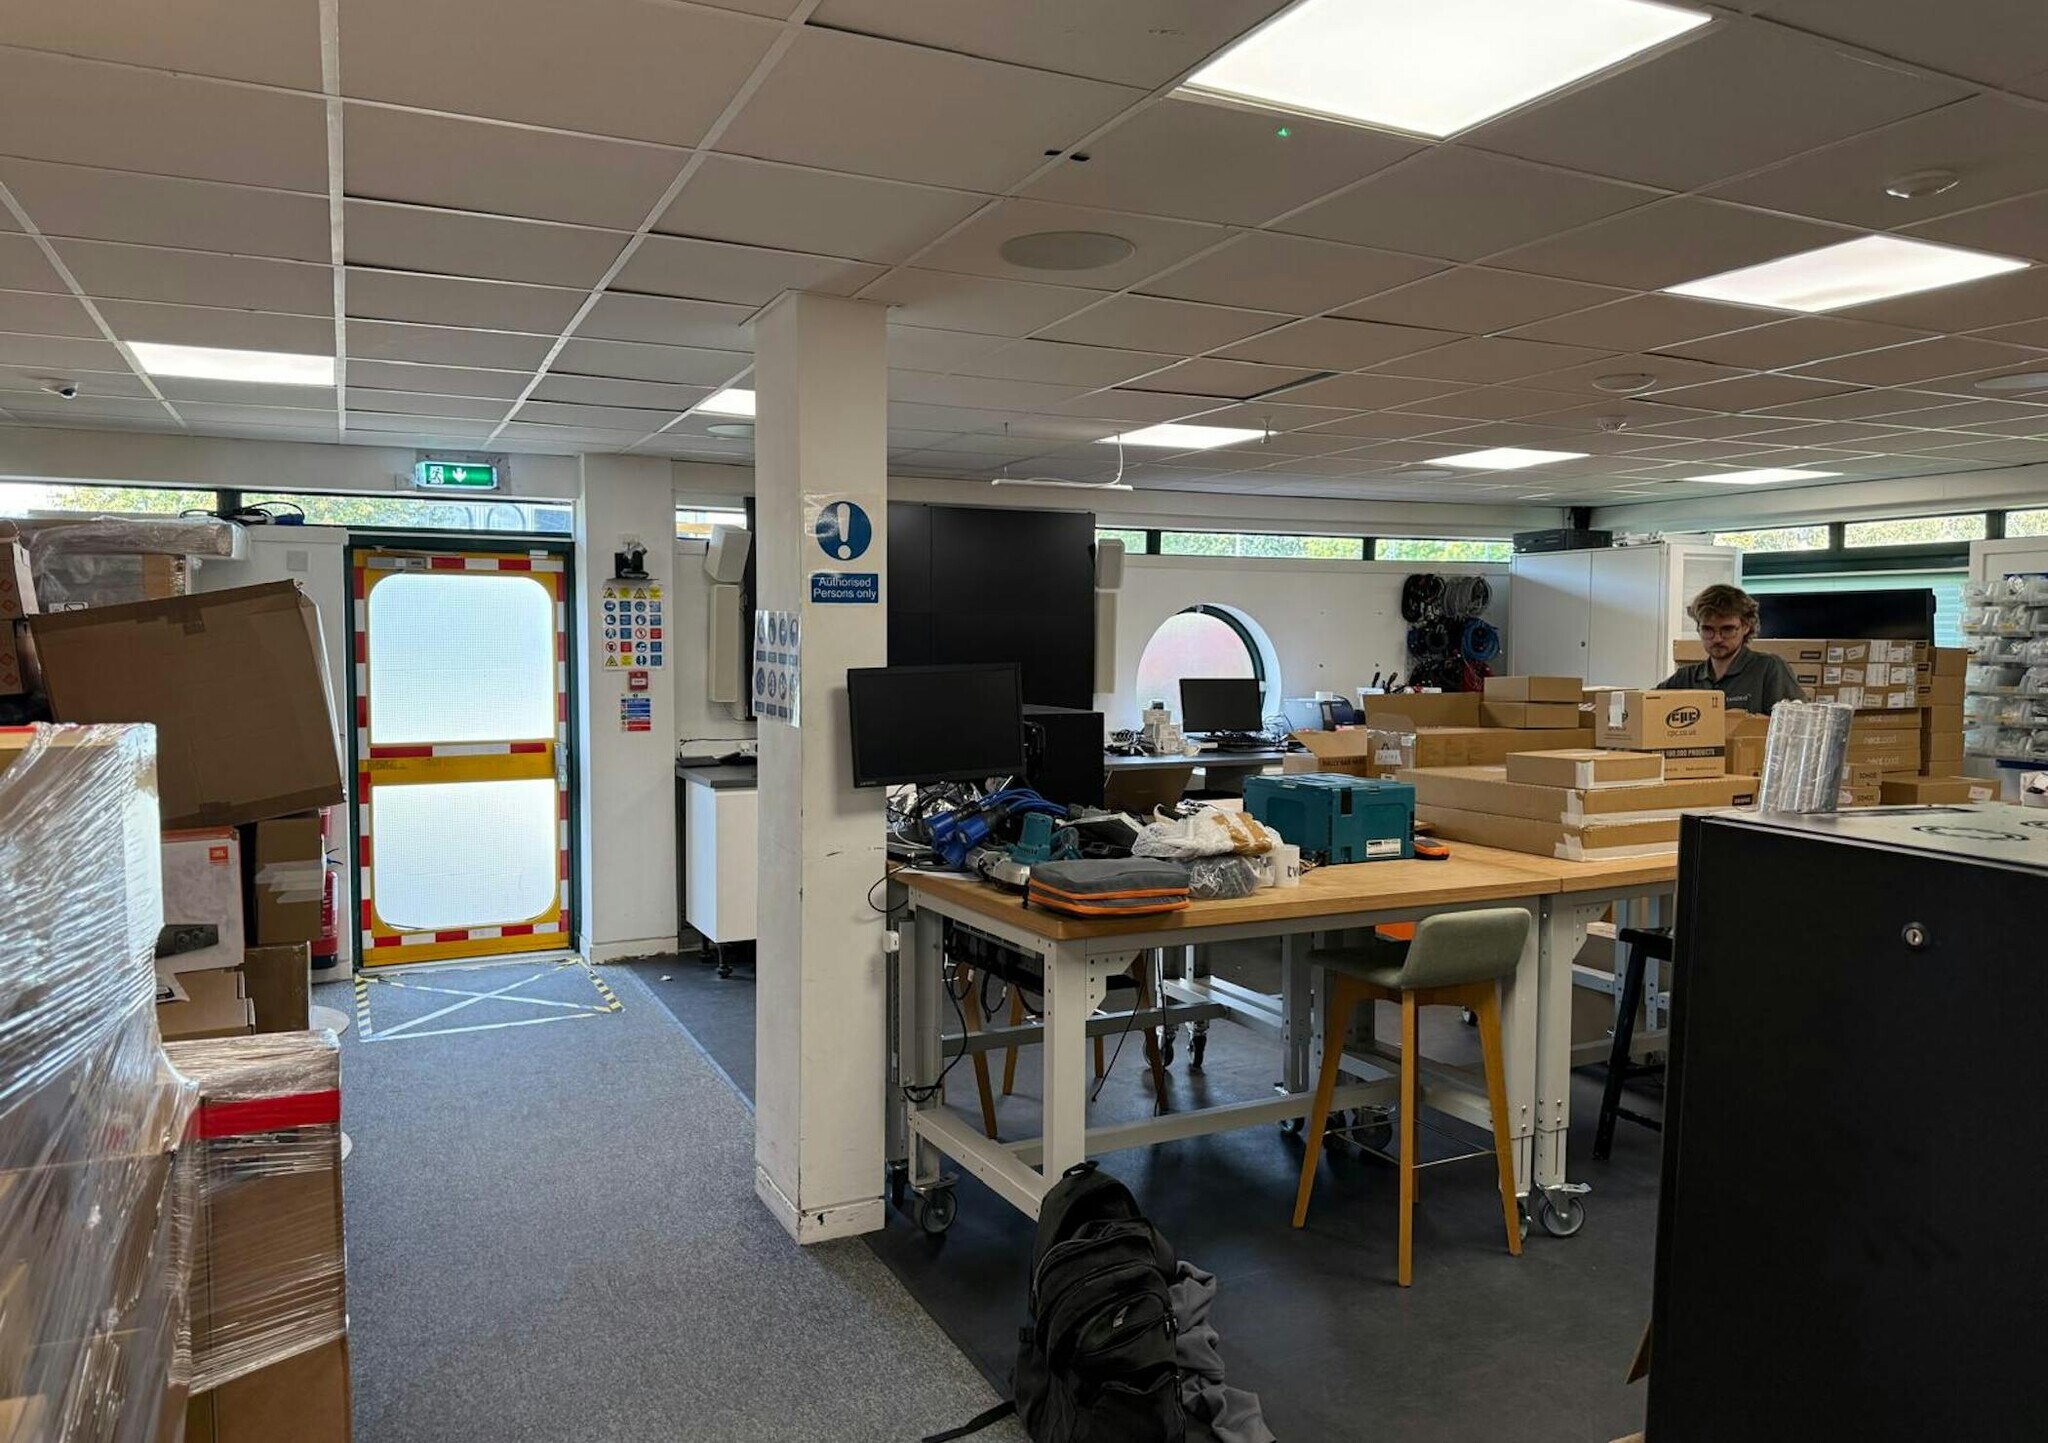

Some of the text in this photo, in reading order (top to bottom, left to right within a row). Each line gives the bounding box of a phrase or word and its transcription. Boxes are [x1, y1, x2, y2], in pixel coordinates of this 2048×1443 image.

[818, 577, 872, 588] Authorised
[813, 588, 876, 600] Persons only
[1687, 748, 1715, 757] PRODUCTS
[1287, 865, 1300, 877] tv
